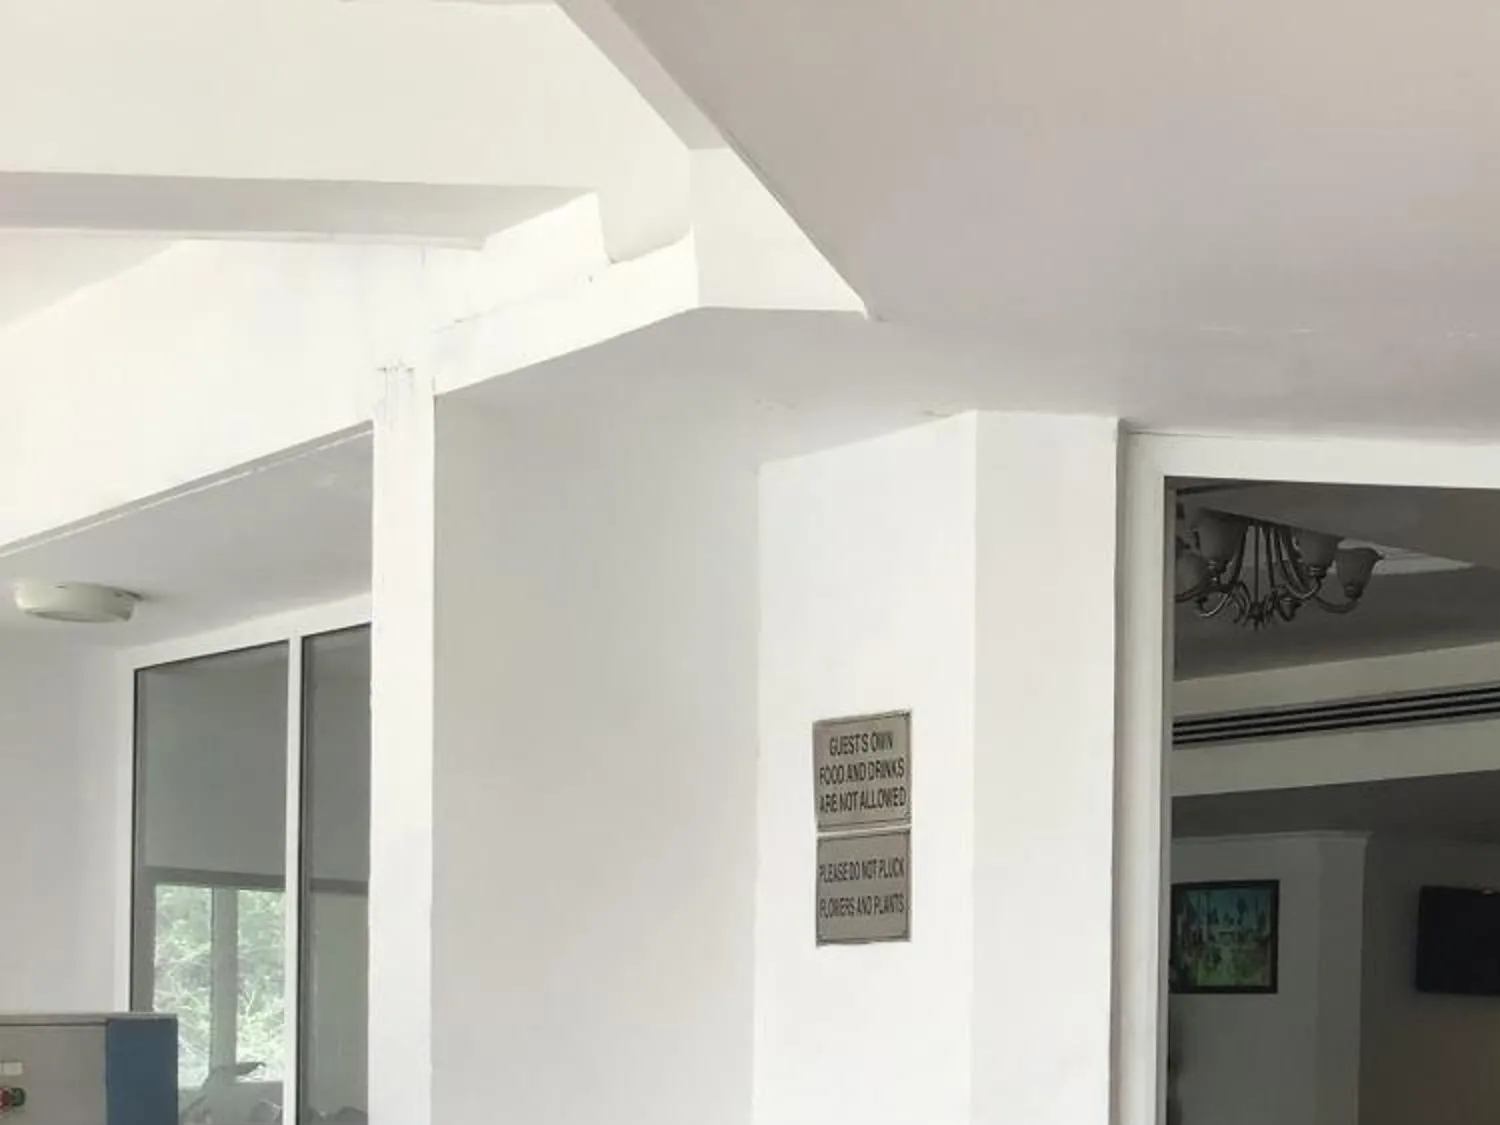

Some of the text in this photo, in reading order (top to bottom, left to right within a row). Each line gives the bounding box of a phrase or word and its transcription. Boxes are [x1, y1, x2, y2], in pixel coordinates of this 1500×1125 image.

[870, 731, 893, 753] OWN
[820, 757, 905, 785] FOOD AND DRINKS
[820, 786, 906, 813] ARE NOT ALLOWED
[819, 856, 905, 883] PLEASE DO NOT PLUCK
[819, 893, 905, 918] FLOWERS AND PLANTS
